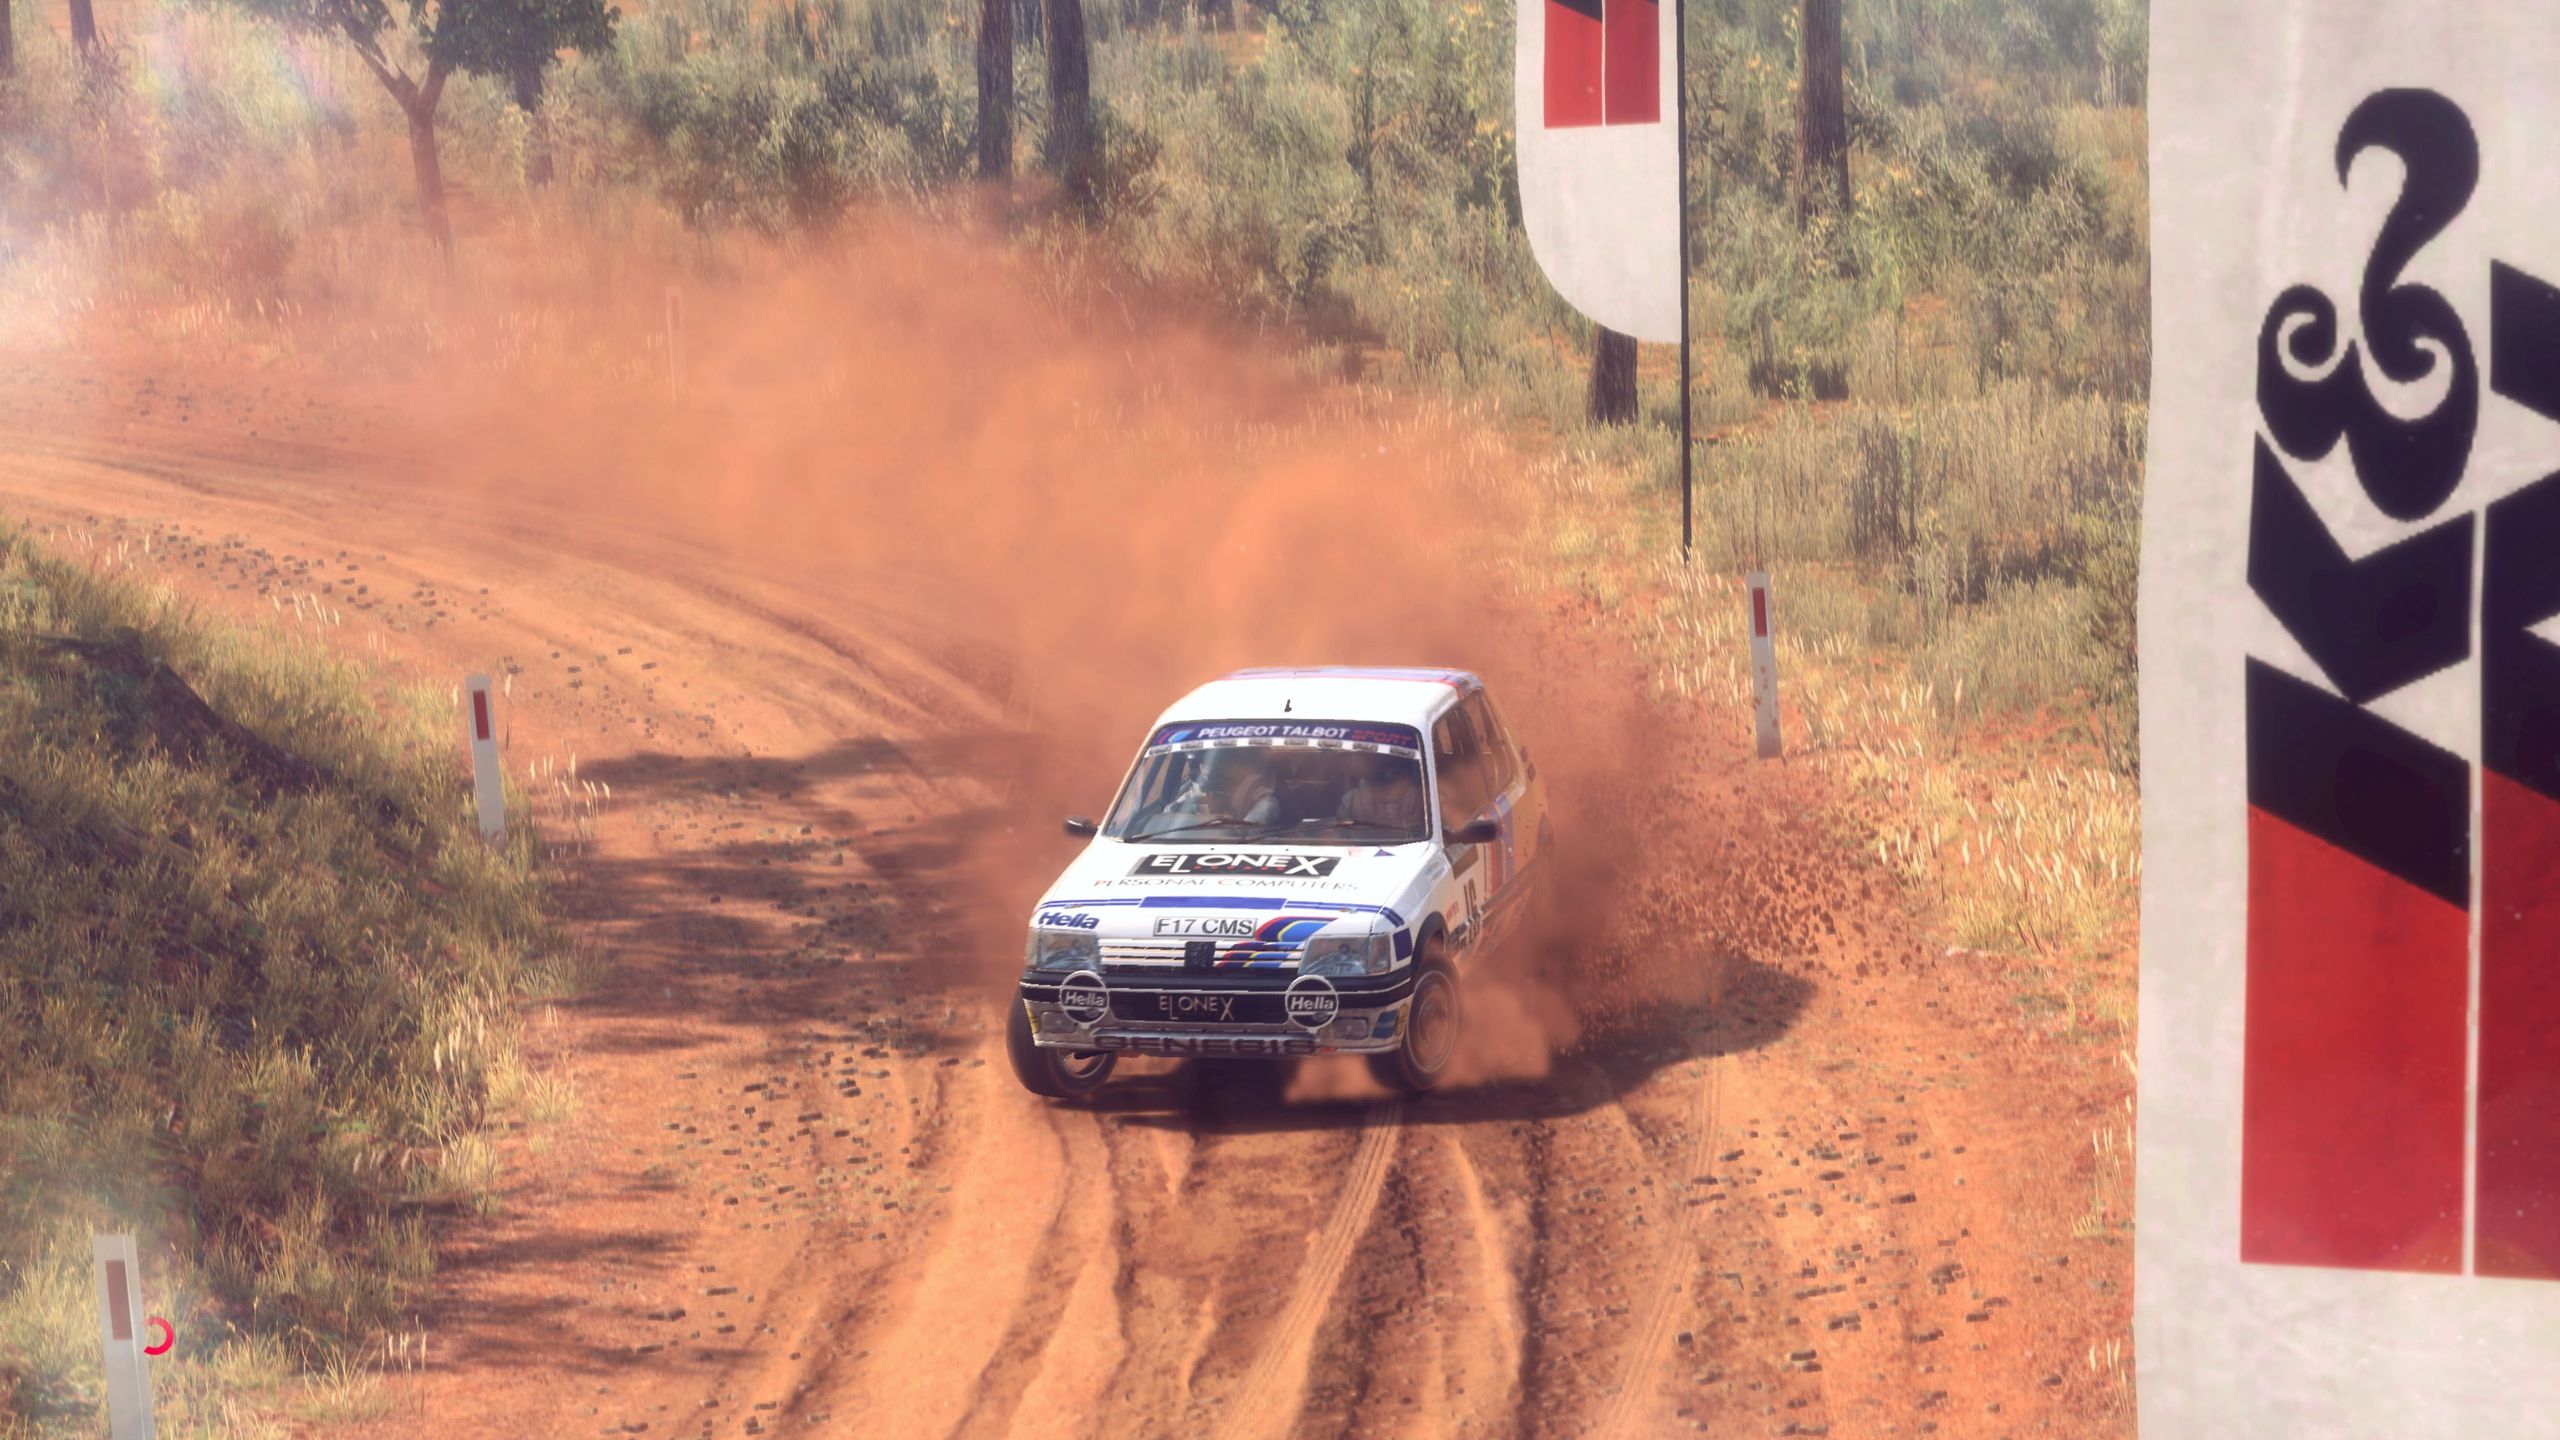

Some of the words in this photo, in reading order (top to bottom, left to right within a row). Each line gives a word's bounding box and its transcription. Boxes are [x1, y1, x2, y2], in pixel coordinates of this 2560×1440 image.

[1197, 725, 1279, 738] PEUGEOT
[1282, 725, 1350, 739] TALBOT
[1151, 854, 1329, 875] ELONEX
[1094, 879, 1206, 888] PERSONAL
[1218, 879, 1358, 890] COMPUTERS
[1038, 912, 1100, 929] Hella
[1156, 918, 1195, 935] F17
[1200, 919, 1253, 936] CMS
[1065, 991, 1104, 1006] Hella
[1290, 996, 1334, 1010] Hella
[1159, 995, 1234, 1021] ELONEX
